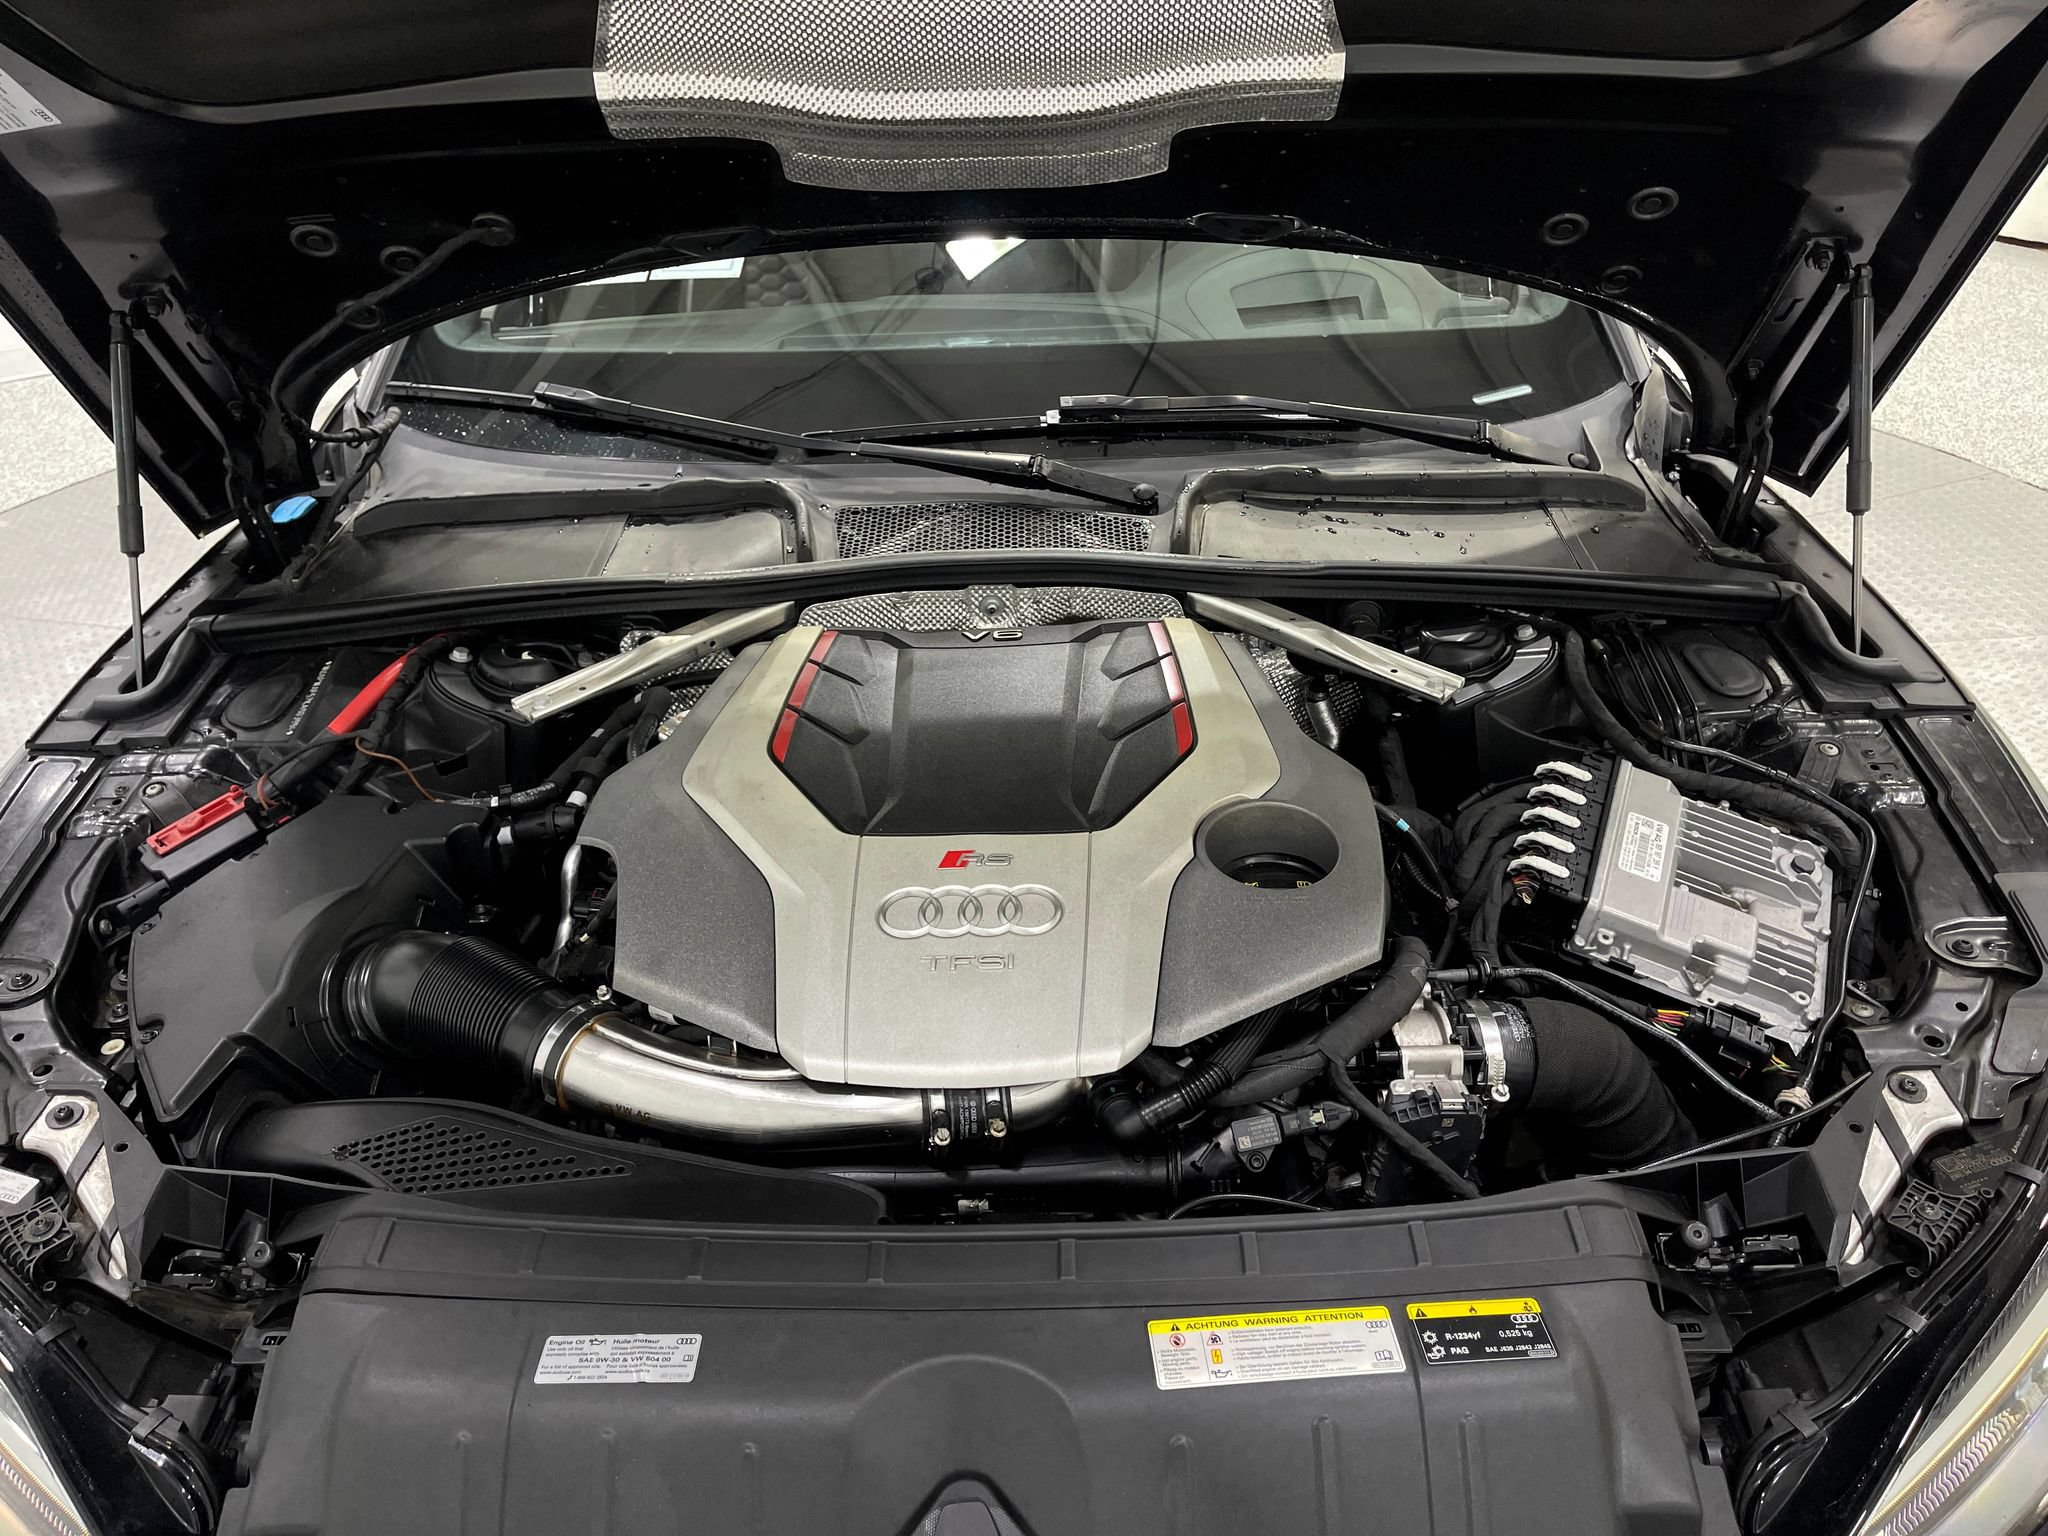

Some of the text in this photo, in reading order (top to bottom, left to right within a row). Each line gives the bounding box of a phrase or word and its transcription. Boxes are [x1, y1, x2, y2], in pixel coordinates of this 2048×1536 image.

[961, 630, 1024, 642] V6
[948, 851, 1013, 868] RS
[920, 953, 1015, 973] TFSI
[616, 1104, 632, 1114] VW
[636, 1110, 651, 1121] AG
[1185, 1320, 1239, 1331] ACHTUNG
[1244, 1315, 1299, 1326] WARNING
[1304, 1312, 1364, 1322] ATTENTION
[1445, 1331, 1481, 1341] R-1234yf
[1522, 1329, 1534, 1338] kg
[1450, 1346, 1470, 1355] PAG
